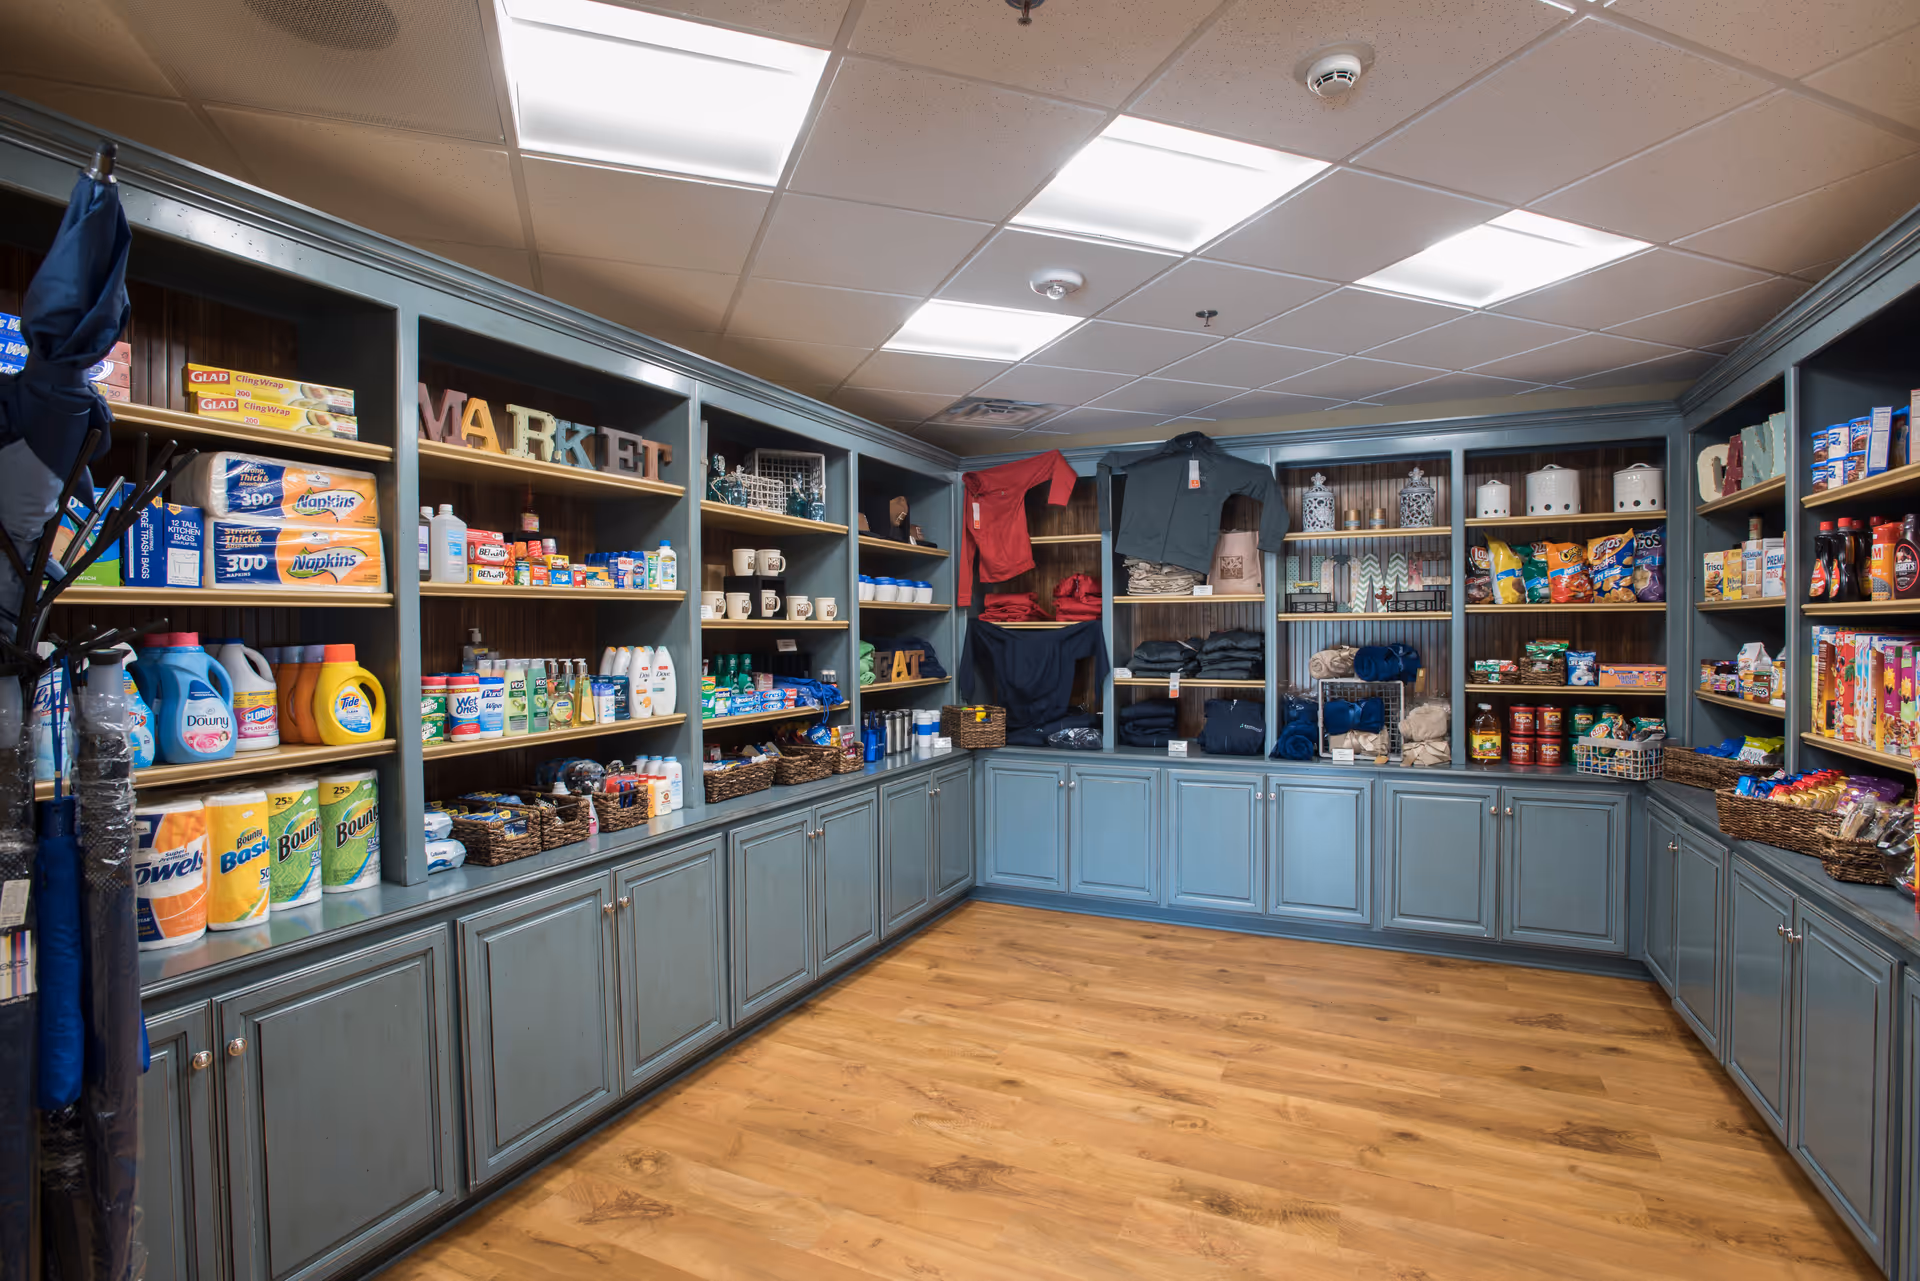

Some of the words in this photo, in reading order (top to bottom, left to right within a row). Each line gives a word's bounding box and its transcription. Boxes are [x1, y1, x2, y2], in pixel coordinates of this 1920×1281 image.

[191, 371, 229, 383] GLAD
[236, 390, 250, 398] 200
[200, 399, 237, 410] GLAD
[241, 492, 274, 506] 300
[296, 495, 356, 511] Napkins
[140, 507, 150, 528] ARGE
[180, 520, 199, 529] TALL
[168, 526, 200, 536] KITCHEN
[174, 534, 196, 542] BAGS
[140, 529, 150, 556] TRASH
[1592, 538, 1622, 560] Fritos
[226, 554, 268, 572] 300
[291, 553, 356, 572] Napkins
[1704, 562, 1724, 571] Triscu
[1766, 554, 1784, 566] PREMI
[140, 556, 150, 579] BAGS
[1766, 569, 1779, 580] minis
[873, 650, 925, 683] EAT
[456, 696, 478, 706] Wet
[762, 690, 784, 699] Crest
[340, 696, 360, 710] Tide
[456, 704, 478, 714] Ones
[245, 707, 274, 722] CLOROX
[187, 715, 229, 729] Downy
[336, 804, 378, 848] Bount
[237, 828, 262, 849] Bounty
[276, 816, 320, 865] Bount
[158, 852, 190, 862] Premium
[165, 849, 185, 857] Super
